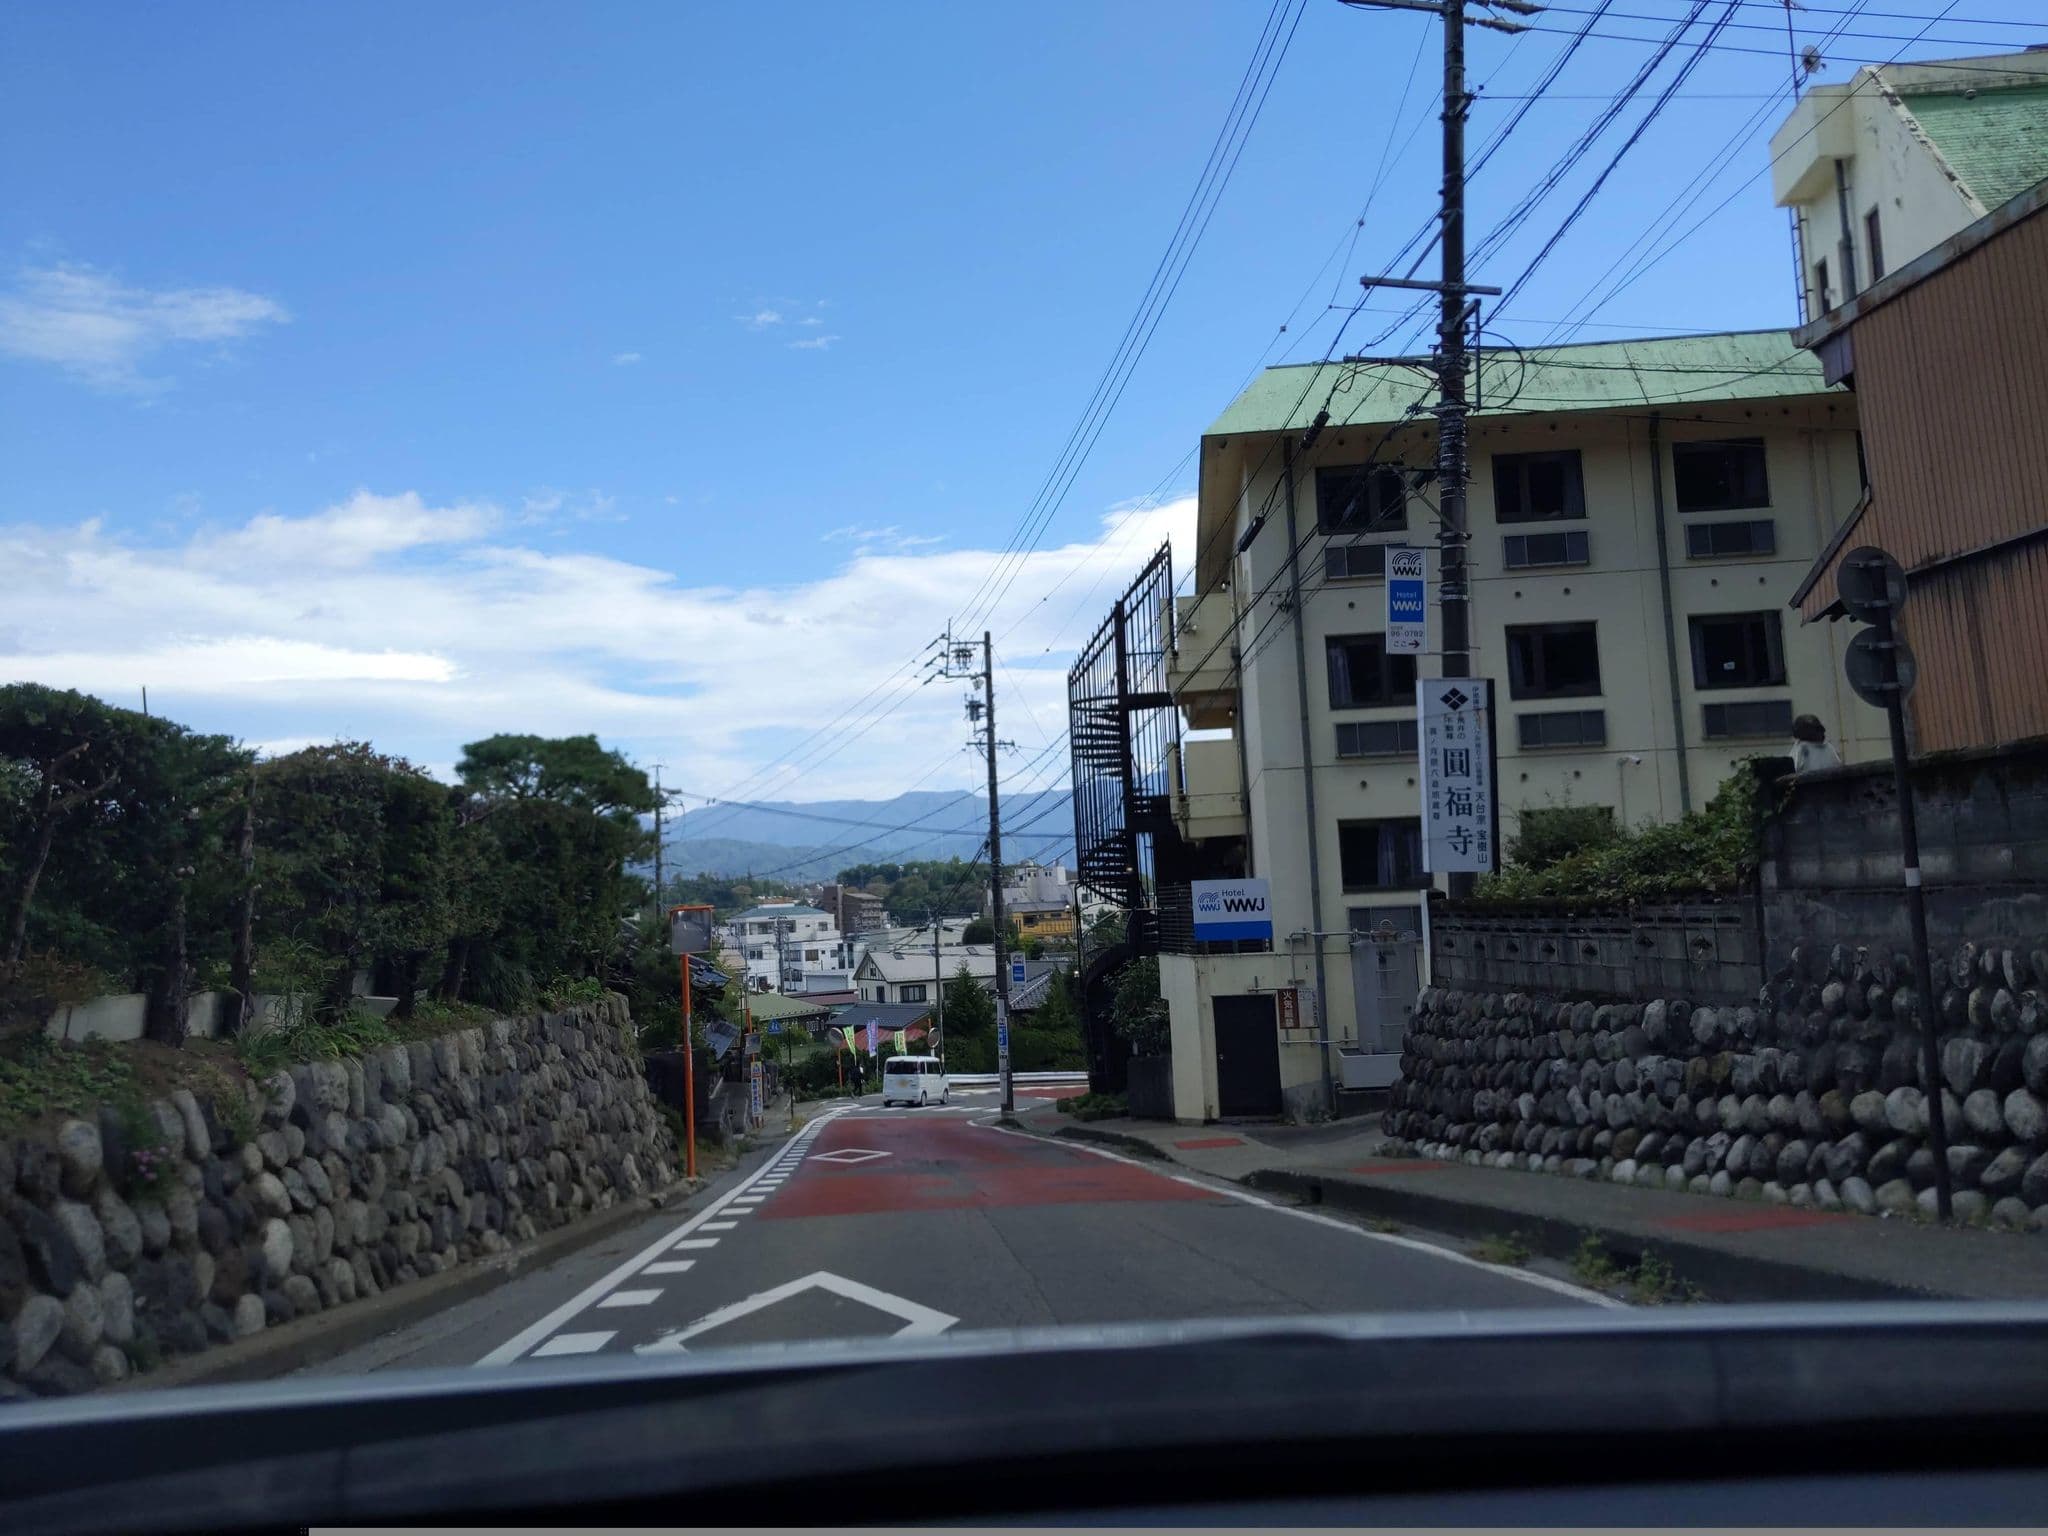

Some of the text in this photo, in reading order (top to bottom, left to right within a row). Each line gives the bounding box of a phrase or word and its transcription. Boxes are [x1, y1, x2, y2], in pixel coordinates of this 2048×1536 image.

[1393, 566, 1422, 576] WWJ
[1392, 601, 1422, 611] WWJ
[1443, 747, 1473, 856] 圓福寺
[1222, 888, 1245, 897] Hotel
[1223, 897, 1265, 912] WWJ
